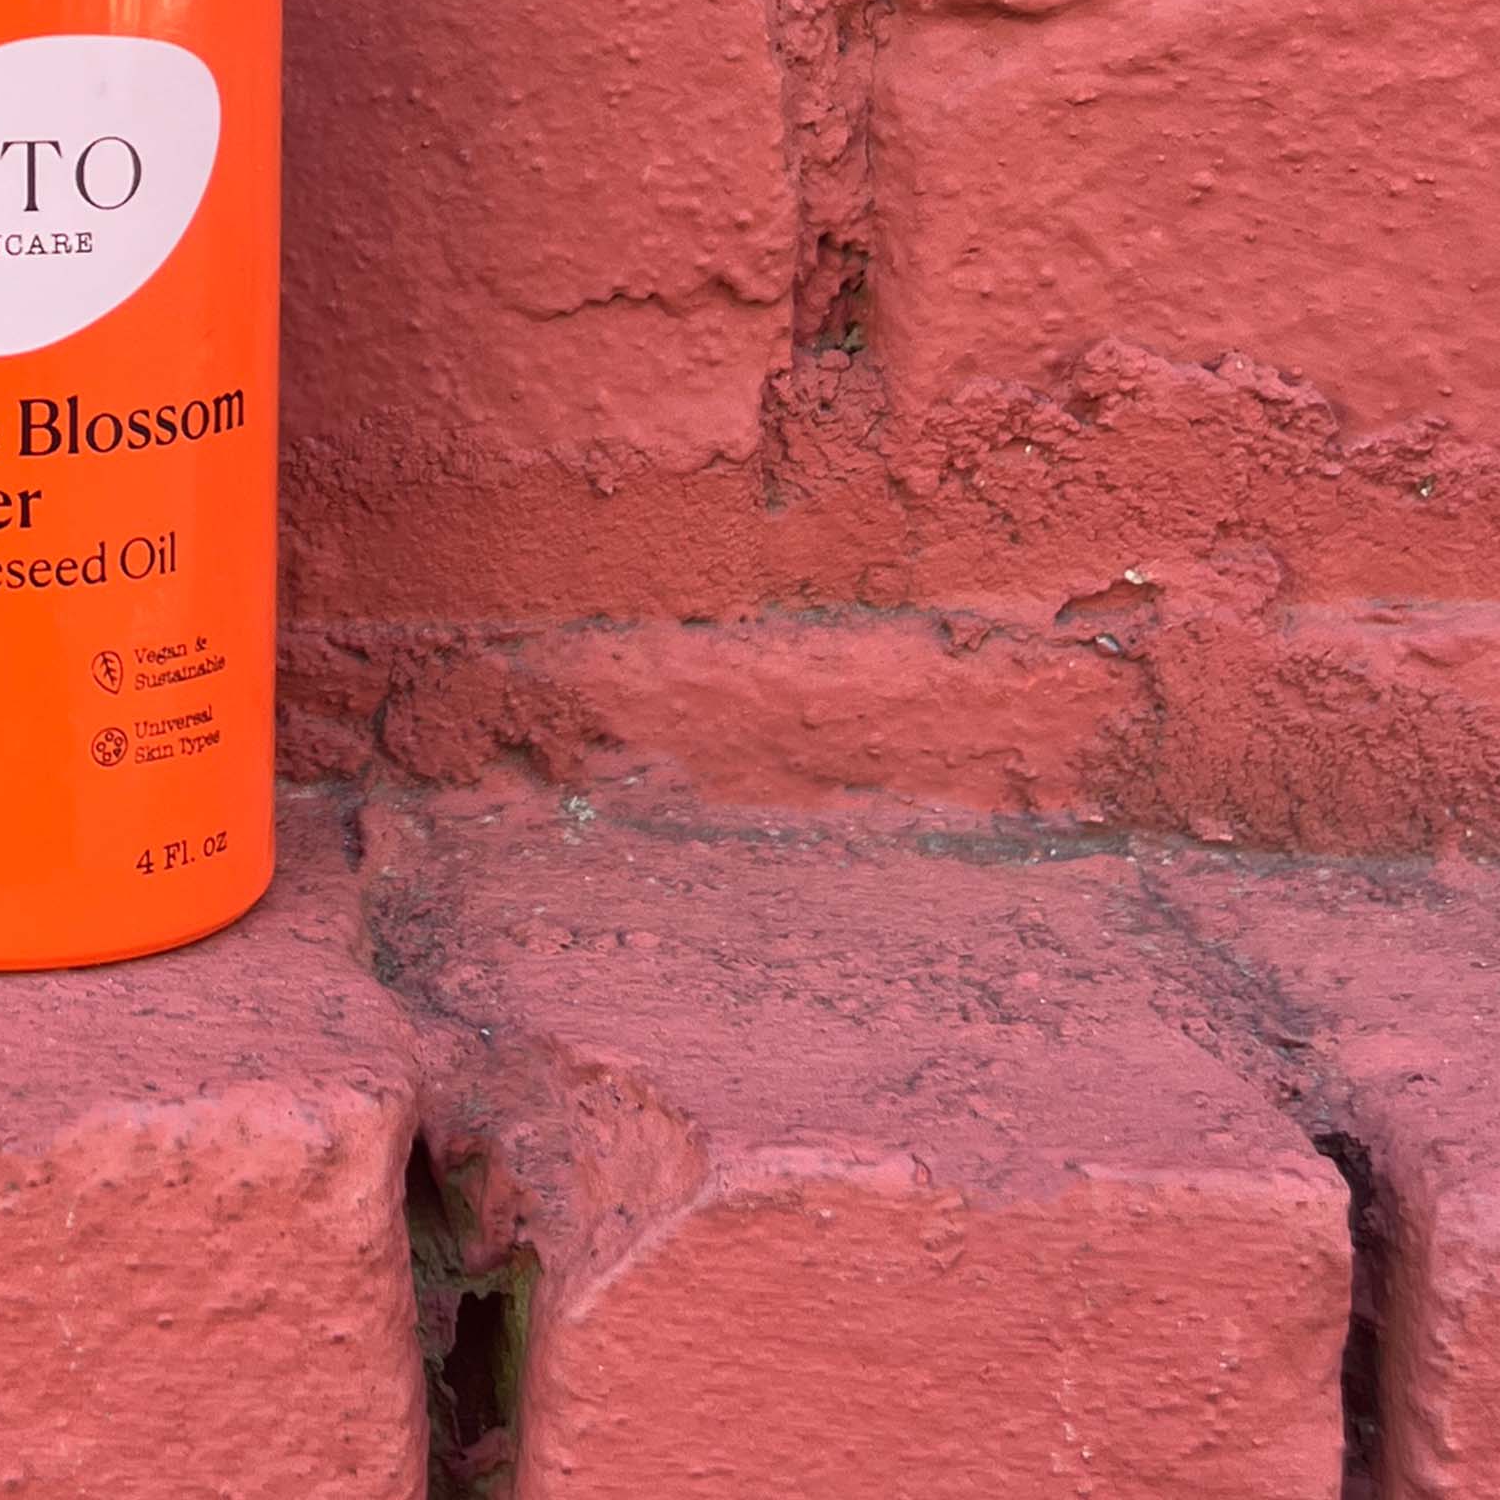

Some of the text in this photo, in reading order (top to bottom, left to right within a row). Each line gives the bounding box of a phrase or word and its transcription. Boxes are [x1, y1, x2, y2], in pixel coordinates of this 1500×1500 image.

[19, 388, 244, 456] Blossom
[120, 531, 177, 580] Oil
[134, 643, 187, 665] Vegan
[134, 704, 213, 739] Universal
[135, 730, 220, 764] Skin Types
[136, 830, 227, 875] 4 Fl. oz
